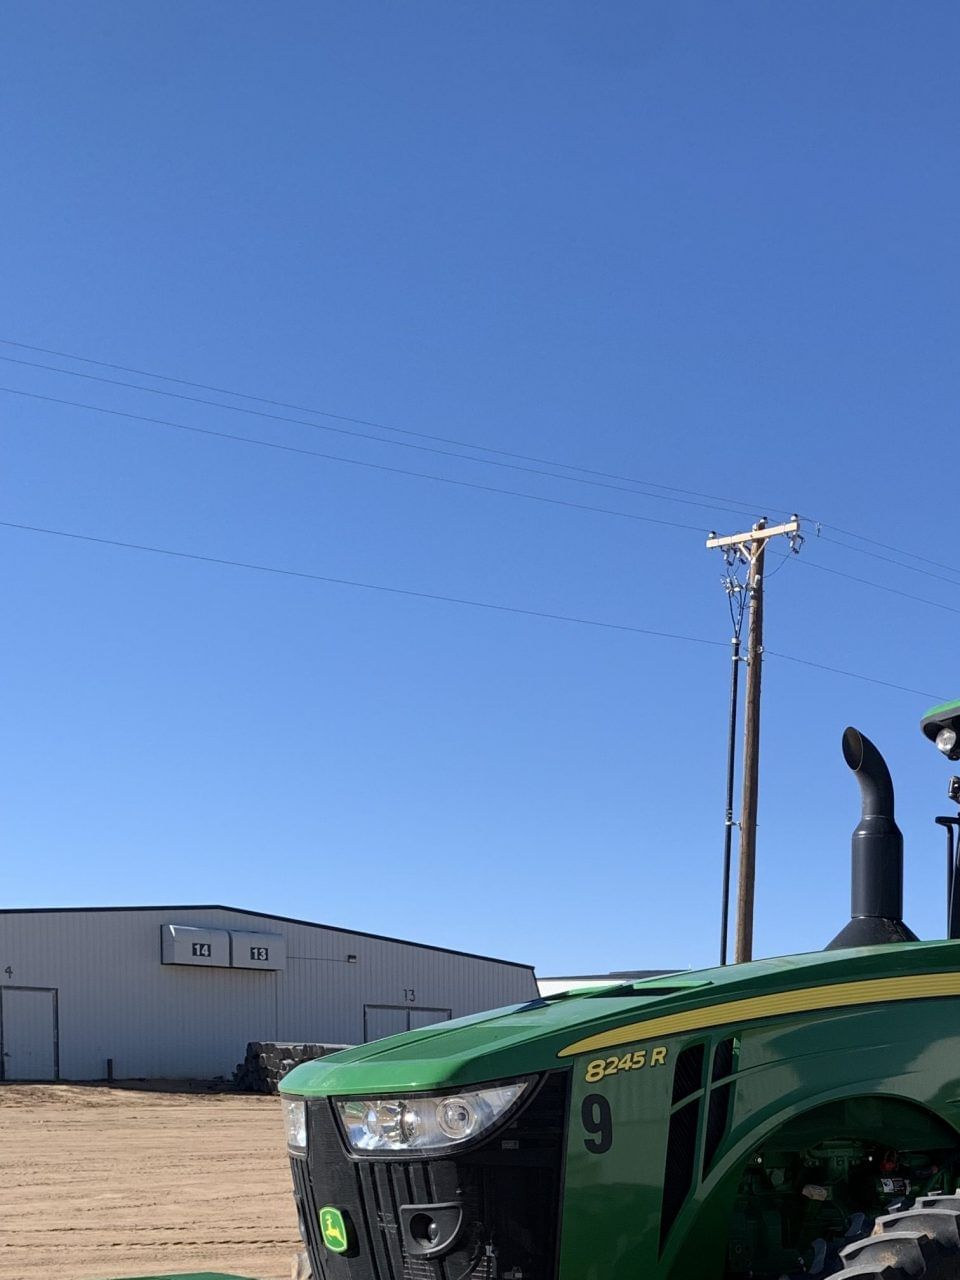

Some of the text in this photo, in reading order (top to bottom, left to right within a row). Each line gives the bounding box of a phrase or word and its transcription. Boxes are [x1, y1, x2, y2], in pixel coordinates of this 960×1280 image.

[194, 944, 210, 958] 14
[252, 948, 267, 961] 13
[4, 966, 14, 980] 4
[402, 988, 416, 1002] 13
[585, 1046, 667, 1083] 8245 R
[581, 1093, 613, 1155] 9
